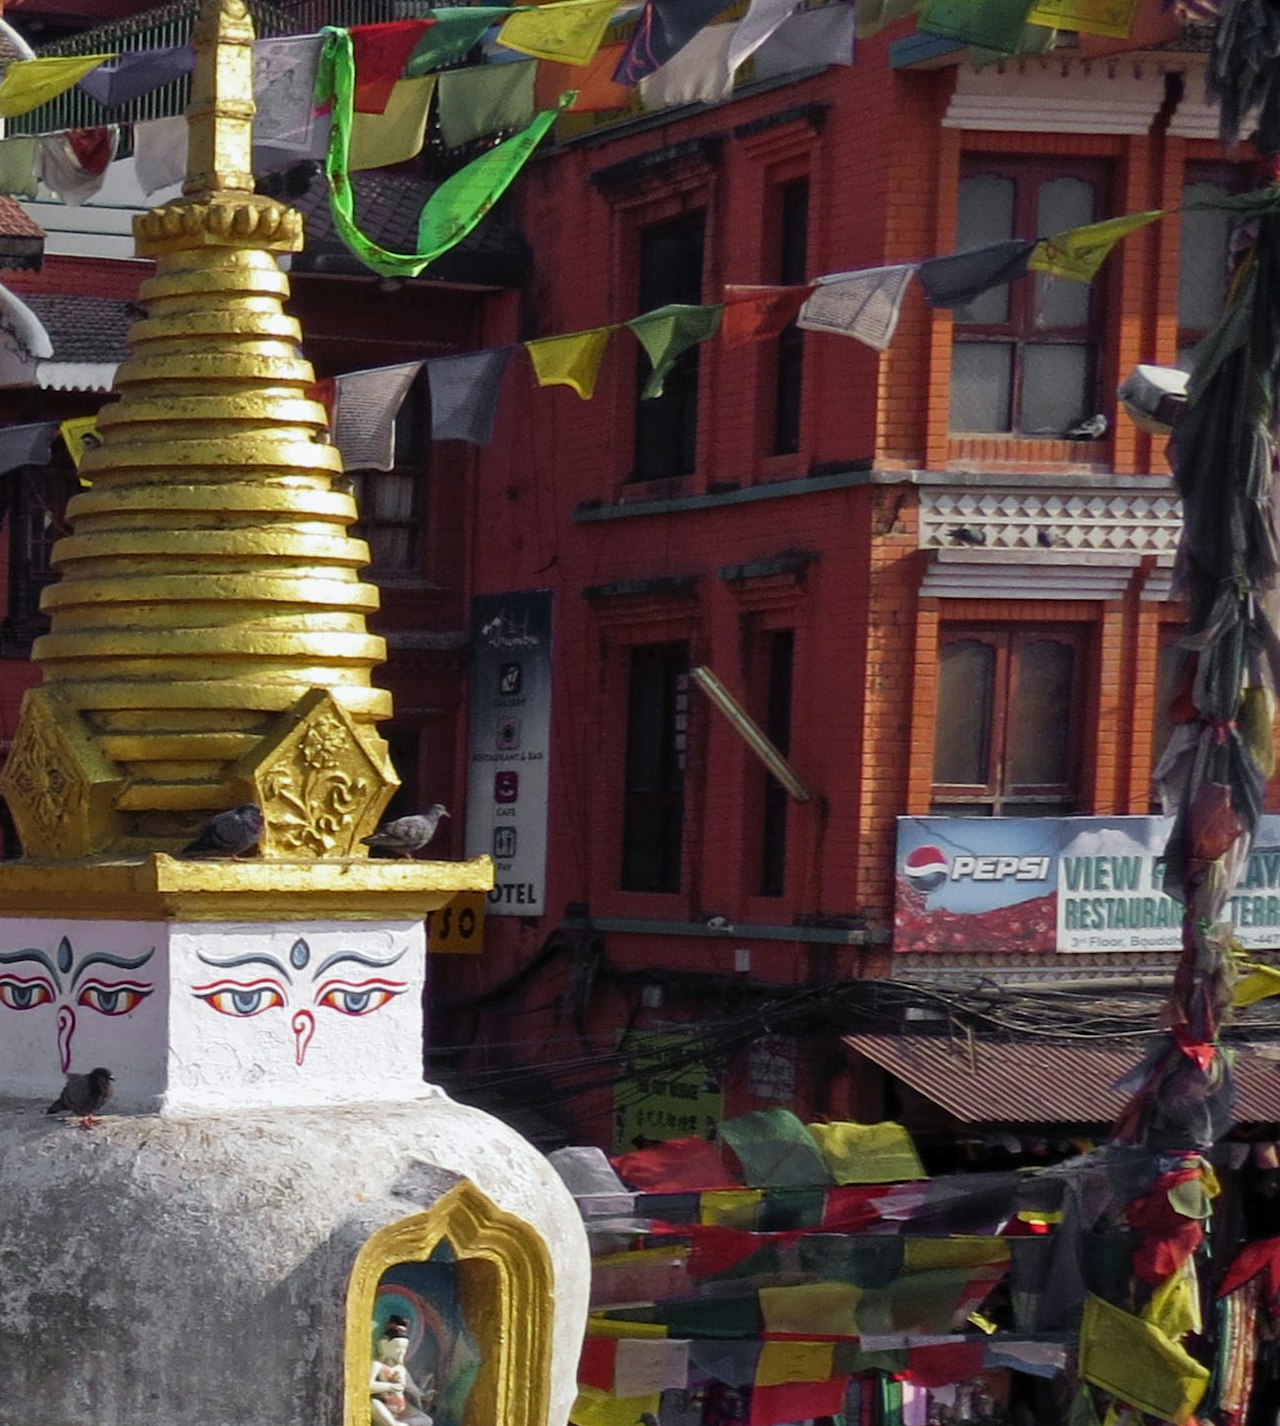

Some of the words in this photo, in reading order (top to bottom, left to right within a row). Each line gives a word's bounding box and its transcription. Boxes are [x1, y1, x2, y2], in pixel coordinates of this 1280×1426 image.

[951, 856, 1051, 881] PEPSI
[1063, 855, 1140, 892] VIEW
[487, 884, 537, 904] OTEL
